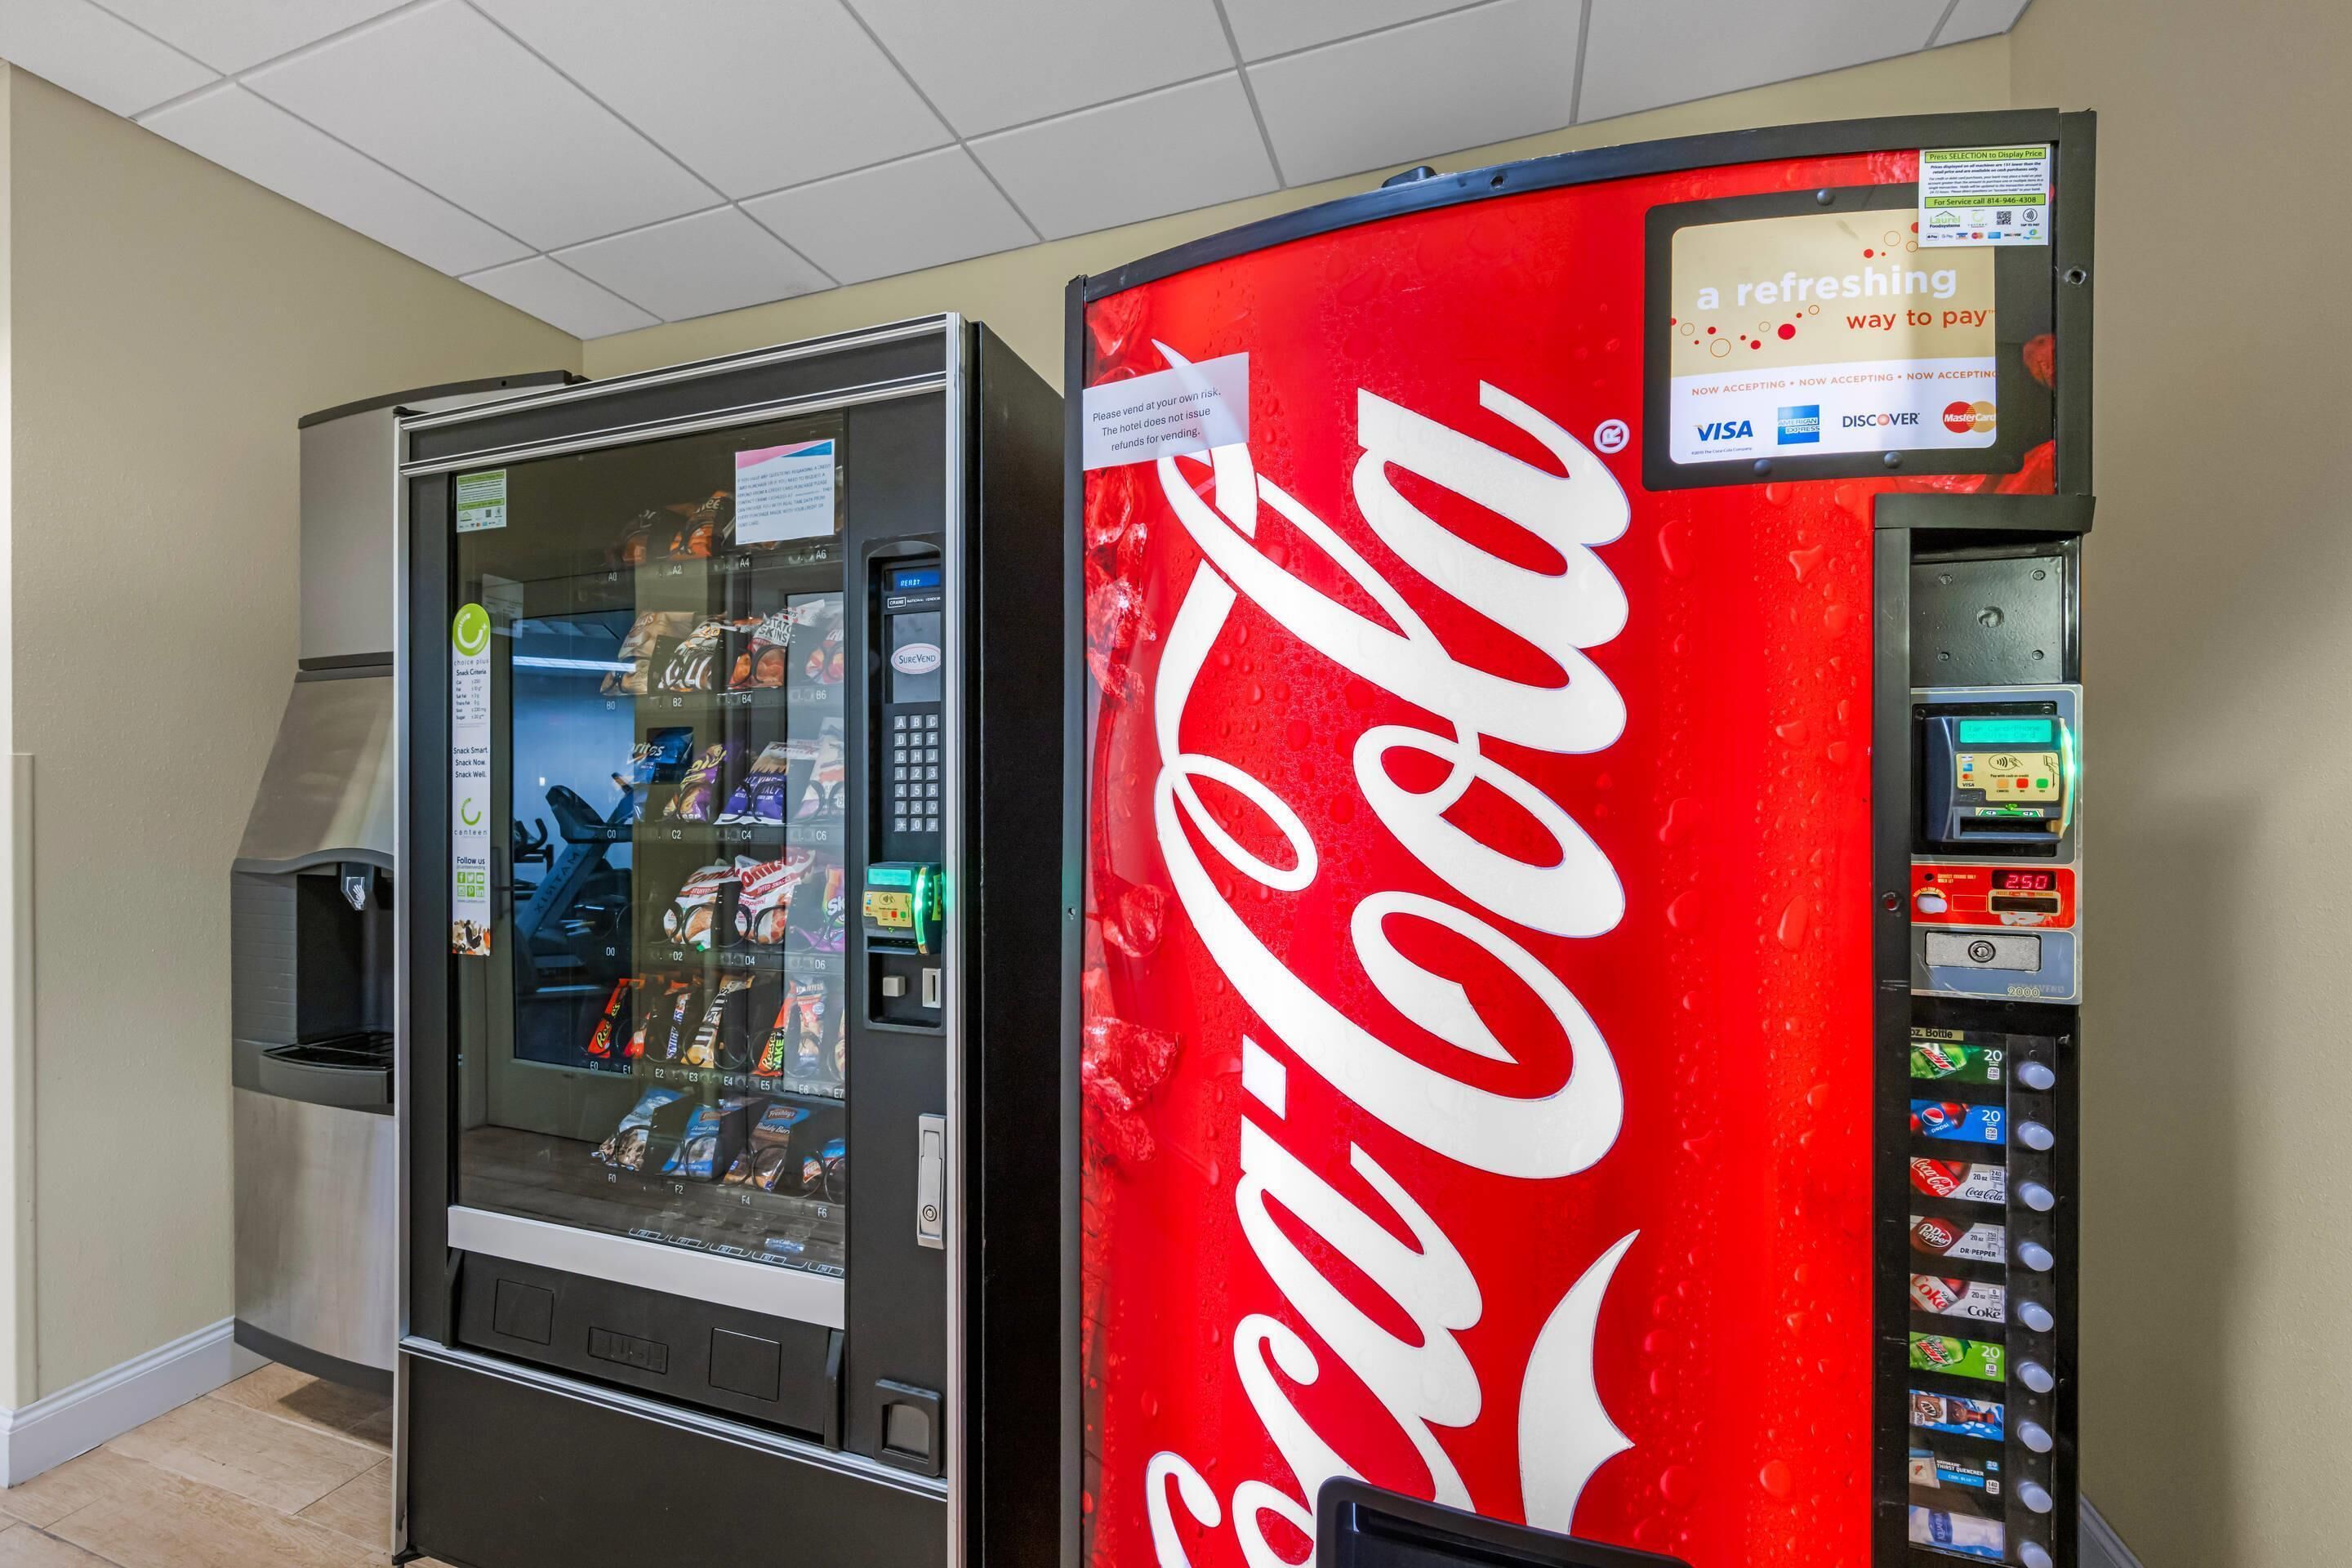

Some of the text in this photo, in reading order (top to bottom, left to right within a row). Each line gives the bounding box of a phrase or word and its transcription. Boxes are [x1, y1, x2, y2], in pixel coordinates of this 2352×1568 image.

[1998, 150, 2024, 158] Display
[1697, 265, 1957, 310] a refreshing
[1846, 313, 1896, 331] way
[1907, 310, 1932, 327] to
[1691, 386, 1719, 396] NOW
[1723, 380, 1786, 393] ACCEPTING
[1799, 377, 1827, 386] NOW
[1830, 373, 1894, 384] ACCEPTING
[1907, 372, 1934, 381] NOW
[1093, 387, 1222, 421] Please vend at your own risk.
[1102, 408, 1211, 436] The hotel does not issue
[1778, 418, 1817, 426] AMERICAN
[1842, 412, 1919, 428] DISCOVER
[1697, 420, 1753, 441] VISA
[1786, 426, 1820, 434] EXPRESS
[1111, 427, 1200, 452] refunds for vending.
[817, 550, 826, 559] A6
[740, 558, 750, 568] A4
[673, 565, 682, 574] A2
[608, 572, 617, 581] A0
[759, 626, 787, 644] SKINS
[742, 694, 751, 703] B4
[817, 690, 826, 699] B6
[607, 702, 615, 710] B0
[673, 697, 682, 706] B2
[898, 717, 935, 727] A B C
[898, 734, 935, 744] D E F
[898, 751, 935, 761] G H J
[915, 769, 920, 777] 2
[930, 768, 935, 777] 3
[898, 786, 935, 795] 4 5 6
[900, 803, 936, 812] 7 8 9
[915, 820, 920, 829] 0
[607, 830, 616, 838] C0
[672, 830, 681, 839] C2
[742, 830, 751, 840] C4
[817, 831, 826, 840] C6
[457, 856, 476, 865] Follow
[2006, 875, 2048, 889] 2.50
[606, 947, 615, 956] D0
[673, 951, 683, 960] D2
[745, 956, 755, 965] D4
[815, 960, 825, 969] D6
[2007, 986, 2040, 998] 2000
[1984, 1049, 2002, 1062] 20
[590, 1062, 598, 1070] E0
[623, 1065, 630, 1073] E1
[655, 1069, 664, 1078] E2
[689, 1073, 697, 1082] E3
[724, 1076, 732, 1085] E4
[761, 1080, 769, 1089] E5
[799, 1085, 808, 1094] E6
[834, 1089, 843, 1098] E7
[1982, 1110, 2001, 1122] 20
[1931, 1123, 1949, 1134] pepsi
[608, 1174, 616, 1183] F0
[675, 1185, 684, 1194] F2
[1966, 1187, 2005, 1201] Coca-Cola
[742, 1196, 750, 1205] F4
[817, 1207, 826, 1217] F6
[1918, 1223, 1949, 1245] Pepper
[1971, 1249, 1996, 1257] PEPPER
[1967, 1305, 2001, 1319] Coke
[1981, 1345, 2000, 1359] 20
[1956, 1467, 1984, 1477] QUENCHER
